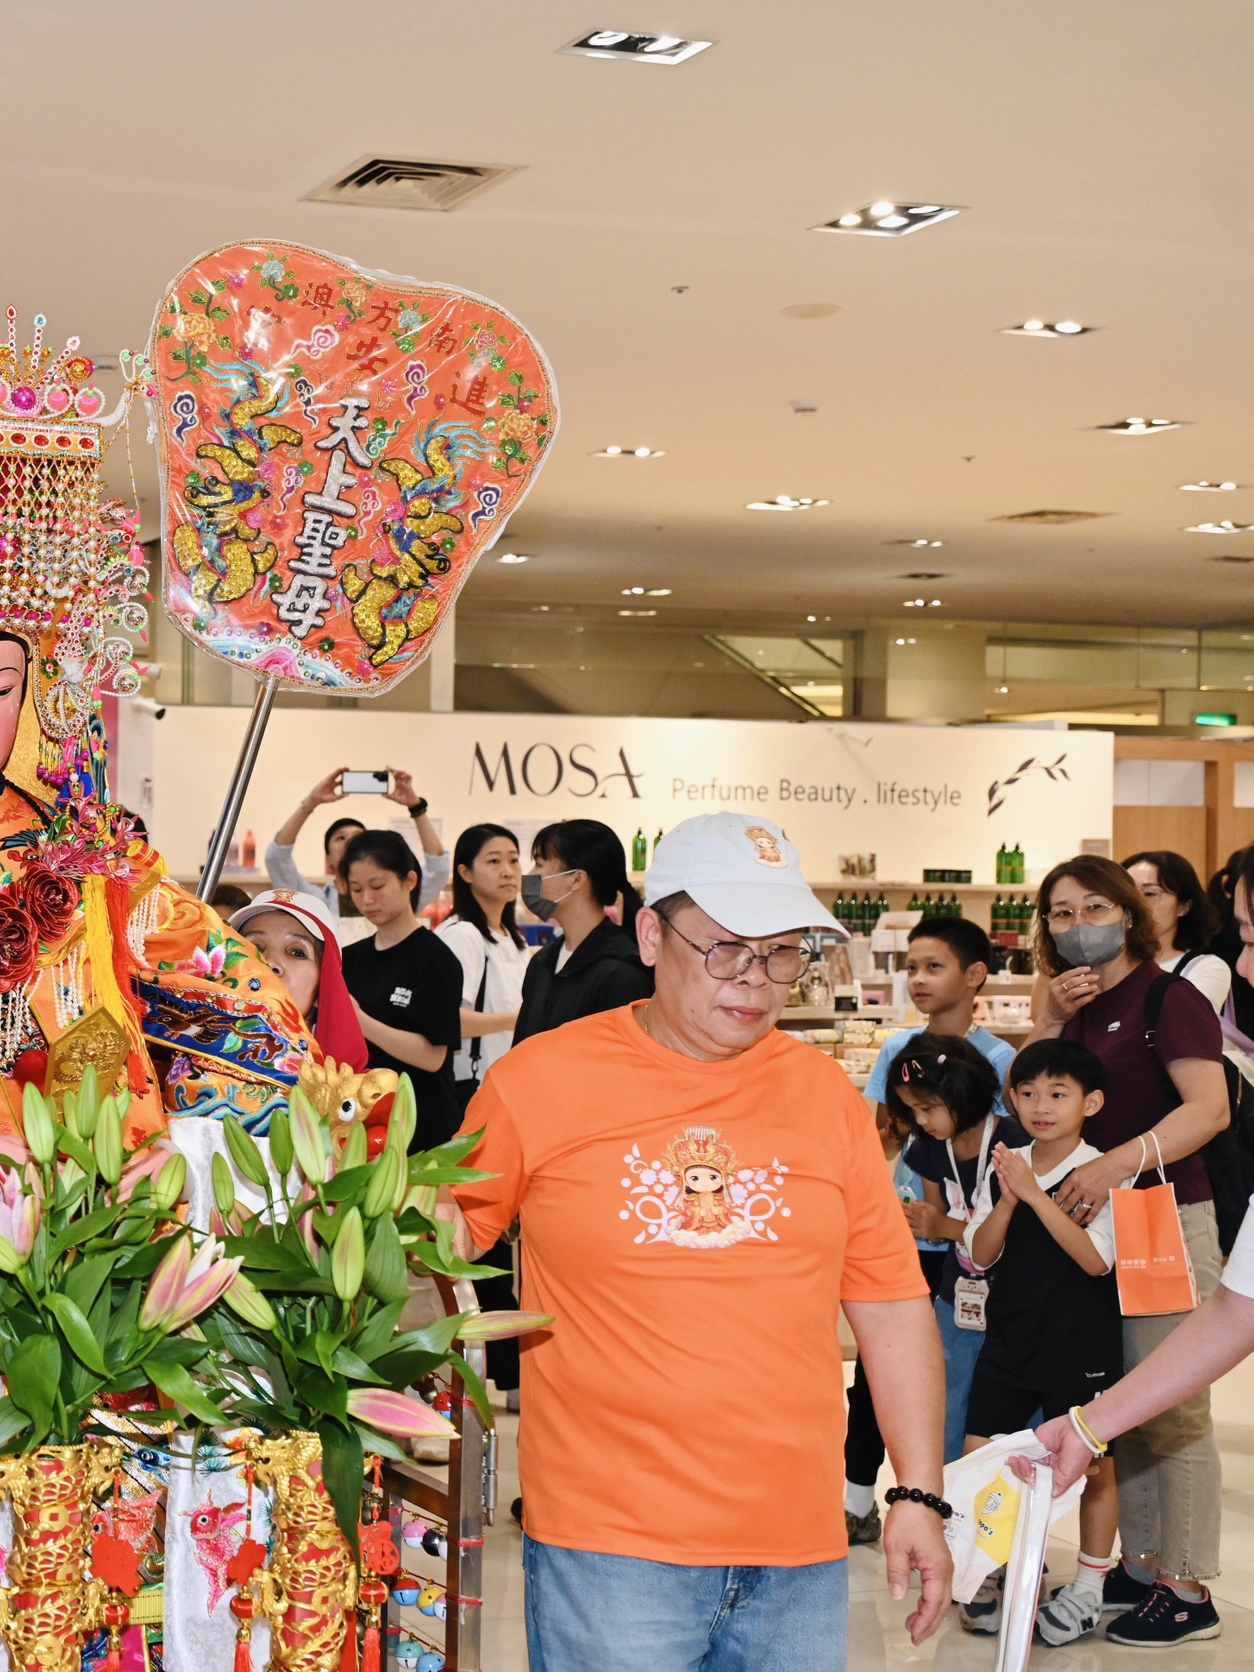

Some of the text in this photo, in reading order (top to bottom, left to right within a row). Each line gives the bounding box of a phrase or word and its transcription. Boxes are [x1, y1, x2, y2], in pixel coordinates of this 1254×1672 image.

[271, 398, 373, 640] 天上聖母
[469, 741, 644, 798] MOSA
[672, 778, 768, 802] Perfume
[779, 778, 856, 810] Beauty
[876, 781, 962, 812] lifestyle
